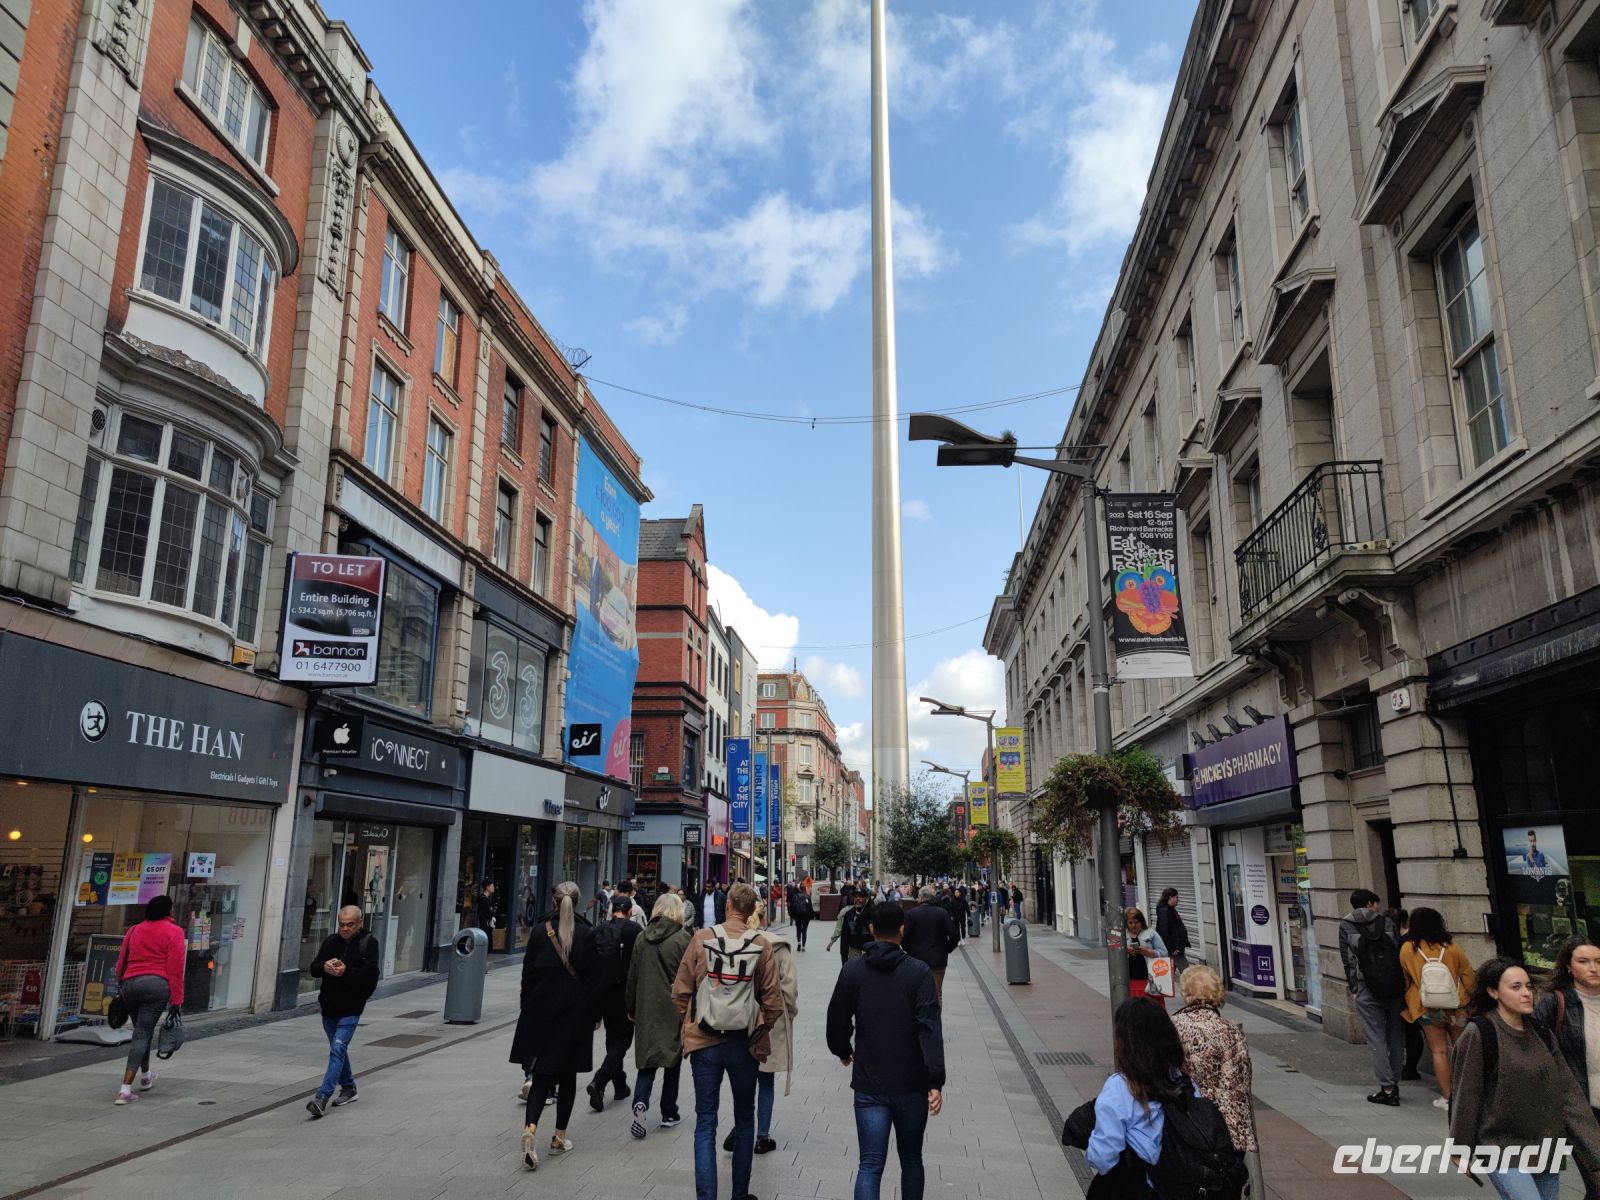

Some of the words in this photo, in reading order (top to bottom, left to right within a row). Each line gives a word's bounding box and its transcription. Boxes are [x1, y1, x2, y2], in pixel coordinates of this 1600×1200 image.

[1127, 510, 1143, 519] Sat
[1144, 510, 1154, 519] 16
[1154, 510, 1173, 520] Sep
[1110, 532, 1137, 550] Eat
[1137, 540, 1150, 550] the
[1123, 547, 1174, 562] Streets
[311, 561, 334, 574] TO
[338, 563, 366, 577] LET
[300, 592, 329, 603] Entire
[331, 594, 370, 608] Building
[298, 607, 317, 615] 534.2
[336, 607, 357, 618] (5,706
[313, 644, 365, 657] bannon
[296, 661, 310, 671] 01
[313, 662, 361, 672] 6477900
[126, 710, 185, 751] THE
[189, 723, 245, 761] HAN
[571, 730, 598, 749] eir
[736, 767, 749, 775] THE
[740, 759, 749, 767] AT
[1200, 757, 1233, 785] HICKEY'S
[1232, 742, 1281, 776] PHARMACY
[210, 771, 234, 782] Electricals
[237, 774, 256, 785] Gadgets
[258, 777, 267, 786] Gift
[268, 778, 278, 788] Toys
[754, 764, 762, 799] DUBLIN
[599, 786, 612, 810] eir
[732, 801, 749, 809] CITY
